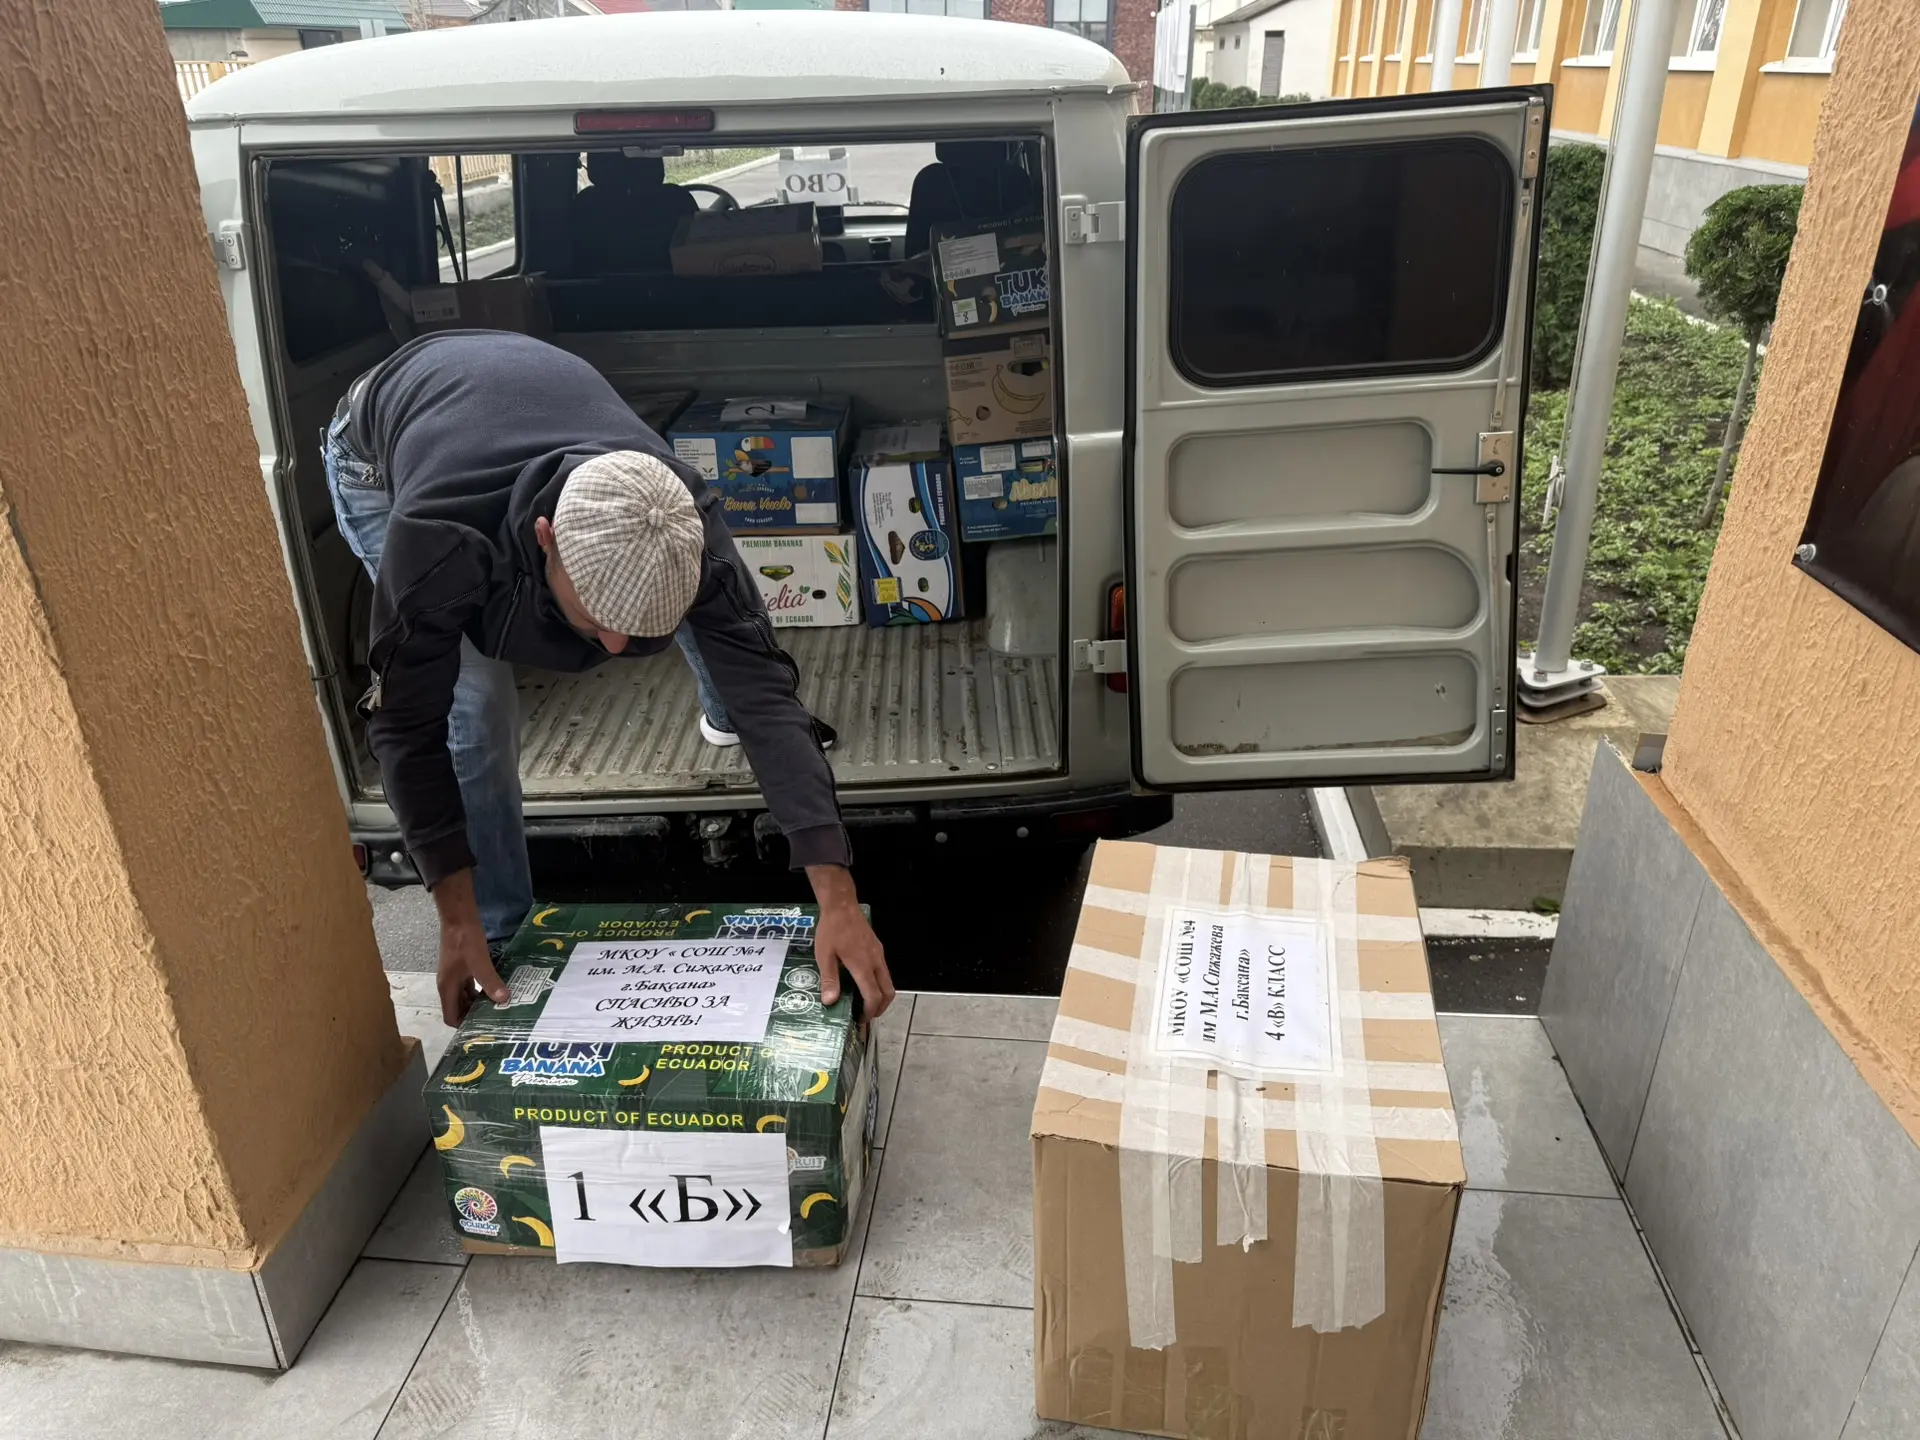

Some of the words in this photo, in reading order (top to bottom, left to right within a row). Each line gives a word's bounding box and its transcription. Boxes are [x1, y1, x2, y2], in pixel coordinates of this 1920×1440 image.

[995, 268, 1048, 297] TUK
[742, 540, 772, 548] PREMIUM
[600, 920, 680, 928] ECUADOR
[722, 914, 814, 928] BANANA
[594, 929, 676, 937] PRODUCT
[597, 947, 665, 961] МКОУ
[680, 946, 732, 958] СОШ
[1174, 942, 1194, 984] «СОШ
[587, 966, 617, 976] им.
[1267, 944, 1286, 998] КЛАСС
[595, 997, 698, 1012] СПАСИБО
[701, 995, 731, 1008] ЗА
[1167, 988, 1189, 1037] МКОУ
[1267, 1002, 1286, 1028] «В»
[610, 1014, 703, 1030] ЖИЗНЬ!
[1202, 1021, 1217, 1043] им
[1264, 1031, 1286, 1042] 4
[661, 1044, 754, 1057] PRODUCT
[499, 1058, 605, 1076] BANANA
[656, 1058, 750, 1071] ECUADOR
[513, 1106, 609, 1123] PRODUCT
[615, 1111, 640, 1125] OF
[647, 1112, 744, 1127] ECUADOR
[794, 1157, 826, 1166] RUIT
[567, 1171, 597, 1222] 1
[629, 1173, 763, 1224] «Б»
[460, 1220, 499, 1231] ecuador
